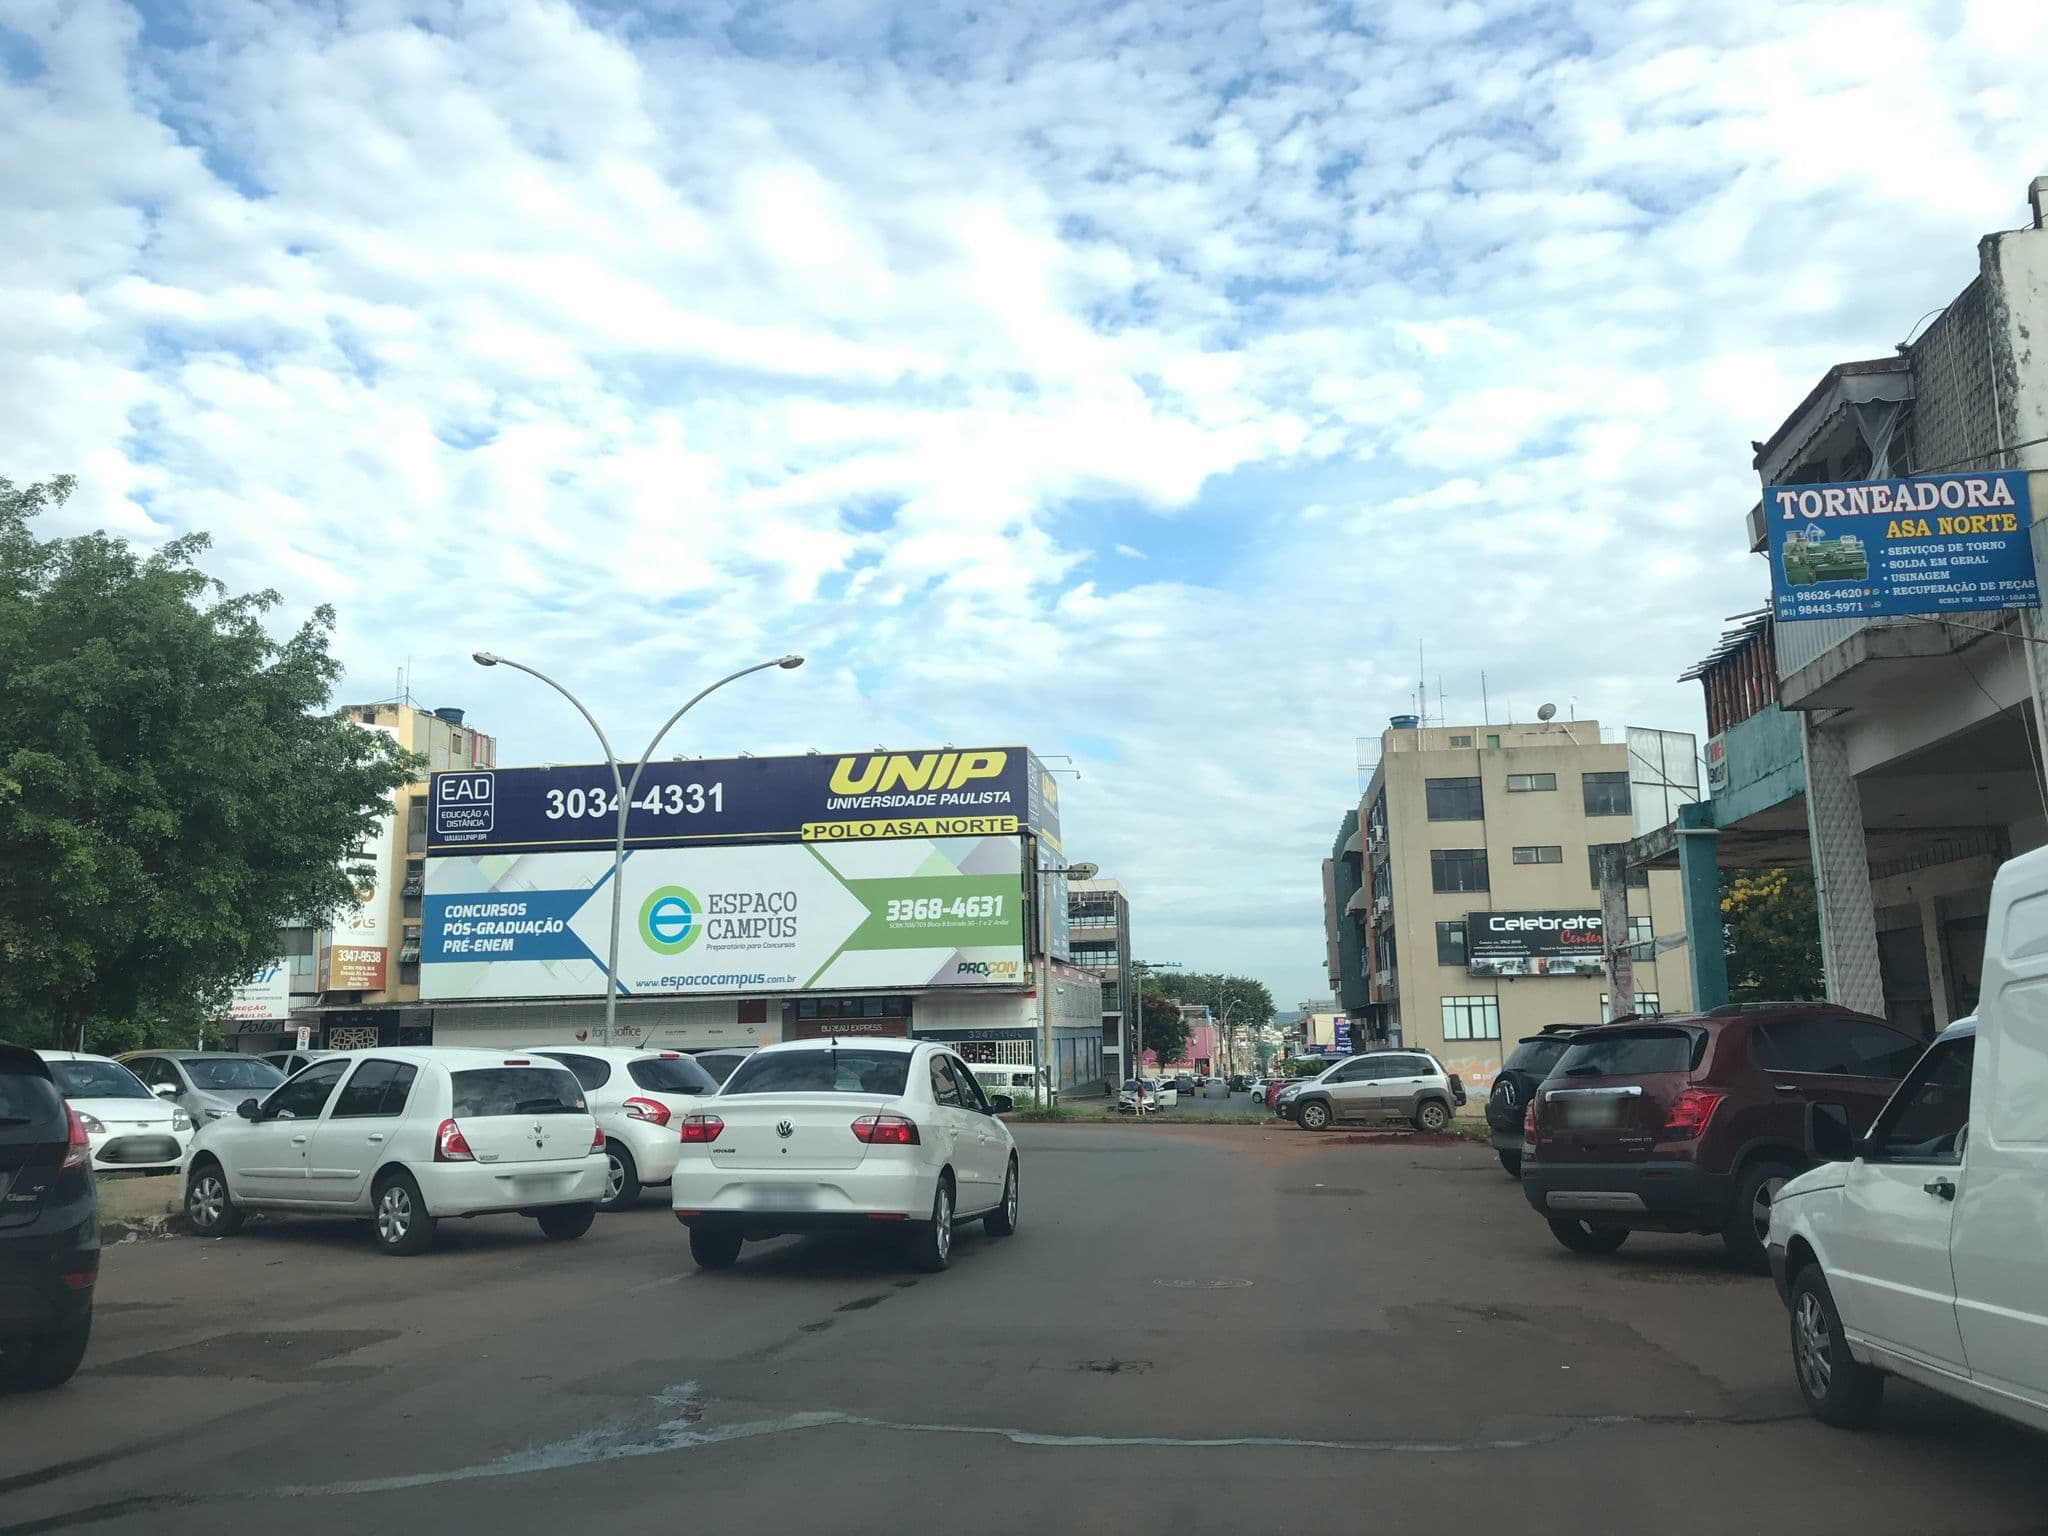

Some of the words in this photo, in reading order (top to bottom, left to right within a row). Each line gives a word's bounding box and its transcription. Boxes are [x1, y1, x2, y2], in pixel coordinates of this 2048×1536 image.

[1776, 477, 2016, 520] TORNEADORA
[1886, 517, 1933, 539] ASA
[1937, 512, 2018, 537] NORTE
[1887, 543, 1946, 556] SERVIÇOS
[1948, 543, 1964, 552] DE
[1966, 540, 2007, 551] TORNO
[1889, 558, 1928, 569] SOLDA
[1930, 557, 1947, 567] EM
[1950, 555, 1989, 565] GERAL
[1890, 570, 1951, 582] USINAGEM
[1779, 594, 1795, 604] (61)
[1796, 588, 1862, 602] 98626-4620
[1892, 581, 1977, 596] RECUPERAÇÃO
[1979, 581, 1996, 591] DE
[1999, 579, 2036, 590] PEÇAS
[1781, 607, 1796, 617] (61)
[1798, 602, 1864, 615] 98443-5971
[829, 751, 1008, 795] UNIP
[442, 779, 490, 801] EAD
[545, 782, 723, 820] 3034-4331
[826, 794, 937, 810] UNIVERSIDADE
[940, 791, 1011, 807] PAULISTA
[441, 808, 482, 819] EDUCAÇÃO
[483, 809, 490, 817] A
[446, 819, 485, 828] DISTÂNCIA
[814, 823, 876, 839] POLO
[882, 821, 929, 836] ASA
[936, 818, 1014, 834] NORTE
[444, 903, 527, 918] CONCURSOS
[708, 891, 798, 915] ESPAÇO
[886, 895, 1004, 921] 3368-4631
[443, 918, 564, 938] PÓS-GRADUAÇÃO
[707, 916, 798, 940] CAMPUS
[1489, 915, 1602, 931] Celebrate
[443, 936, 514, 953] PRÉ-ENEM
[1559, 929, 1603, 945] Center
[338, 949, 382, 963] 3347-9538
[636, 973, 797, 990] www.espacocampus.com.br
[238, 1020, 278, 1033] Polar
